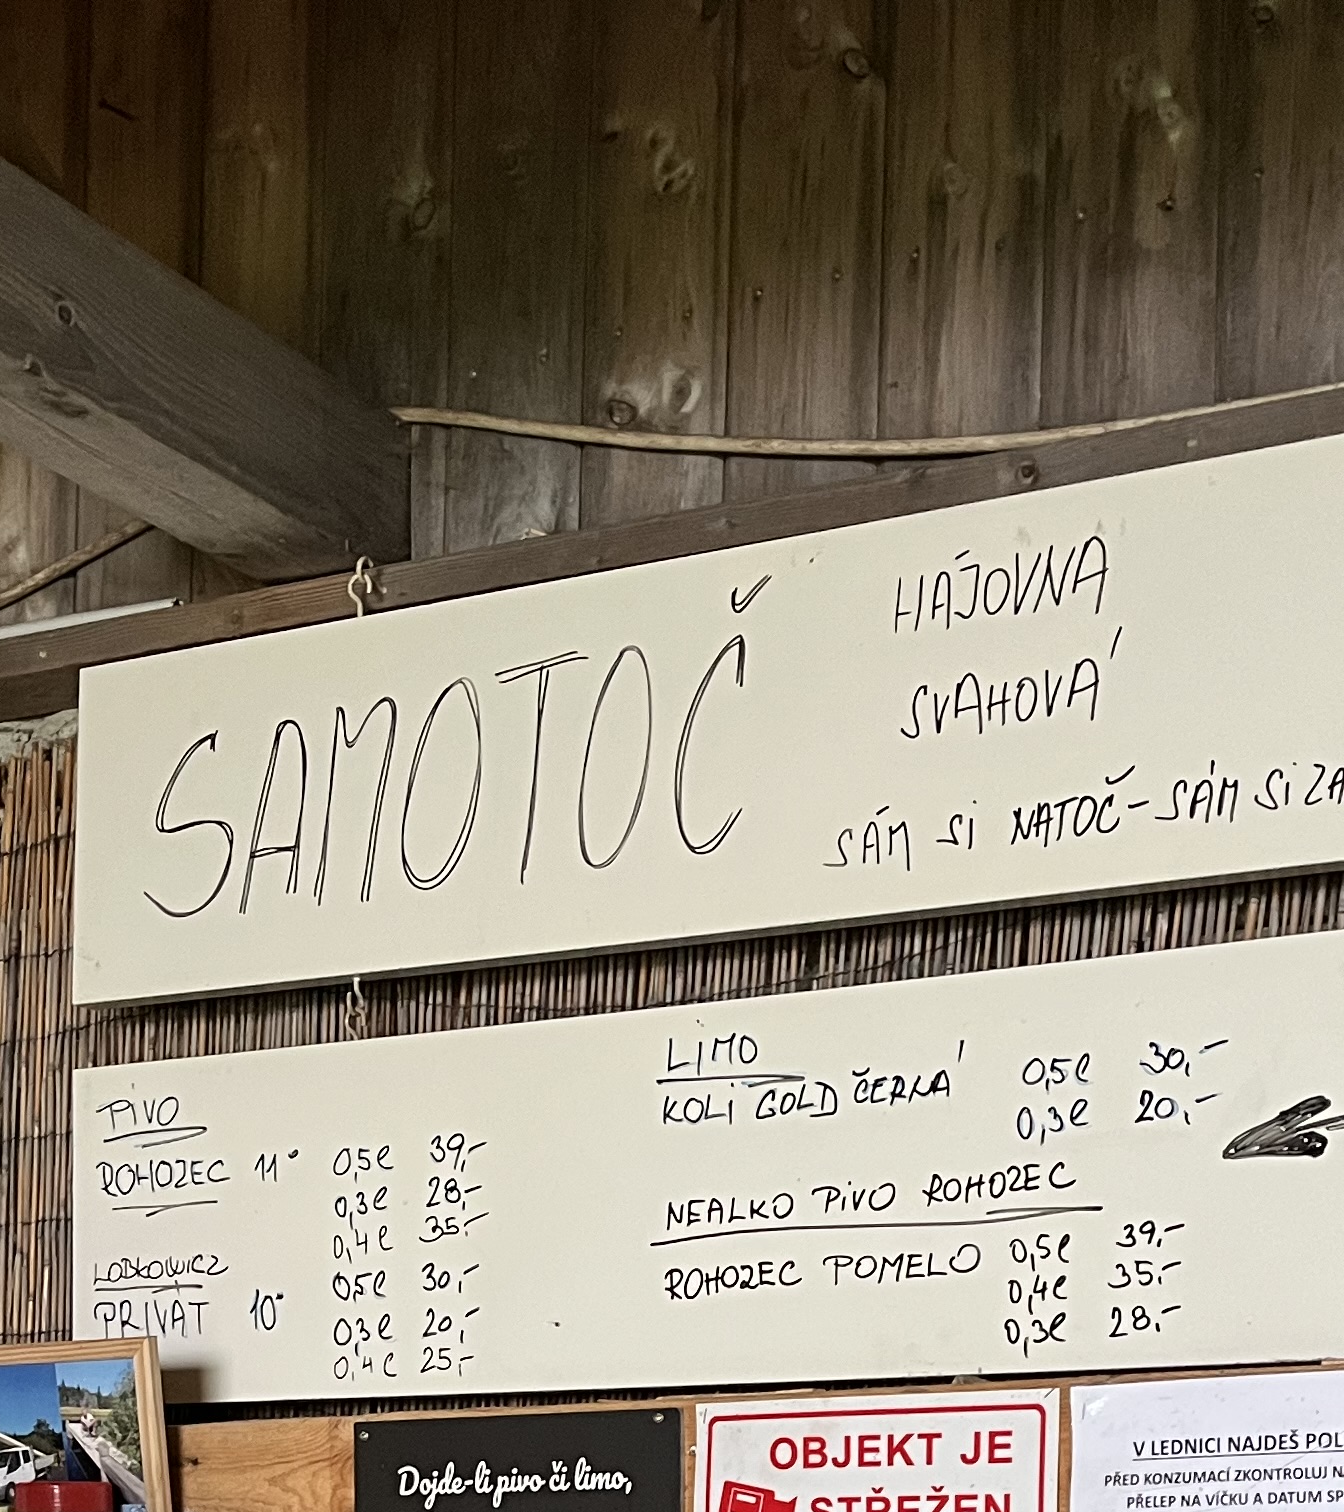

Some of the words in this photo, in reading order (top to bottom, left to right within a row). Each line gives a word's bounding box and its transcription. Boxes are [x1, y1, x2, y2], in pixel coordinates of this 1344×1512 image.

[901, 625, 1123, 740] SVAHOVÁ
[143, 574, 772, 918] SAMOTOČ
[824, 805, 910, 871] SÁM
[666, 1191, 794, 1230] NEALKO
[824, 1243, 983, 1286] POMELO
[770, 1432, 942, 1470] OBJEKT
[960, 1430, 1013, 1466] JE
[1133, 1441, 1146, 1456] V
[1150, 1437, 1222, 1456] LEDNICI
[1227, 1429, 1299, 1452] NAJDEŠ
[397, 1464, 492, 1510] Dojde-li
[494, 1469, 545, 1509] pivo
[549, 1459, 571, 1493] či
[574, 1457, 633, 1496] limo,
[1104, 1470, 1140, 1487] PŘED
[1144, 1466, 1231, 1486] KONZUMACÍ
[1234, 1466, 1327, 1482] ZKONTROLUJ
[1126, 1492, 1176, 1509] PŘELEP
[1180, 1493, 1201, 1507] NA
[1206, 1490, 1248, 1506] VÍČKU
[1253, 1492, 1263, 1504] A
[1267, 1490, 1322, 1504] DATUM
